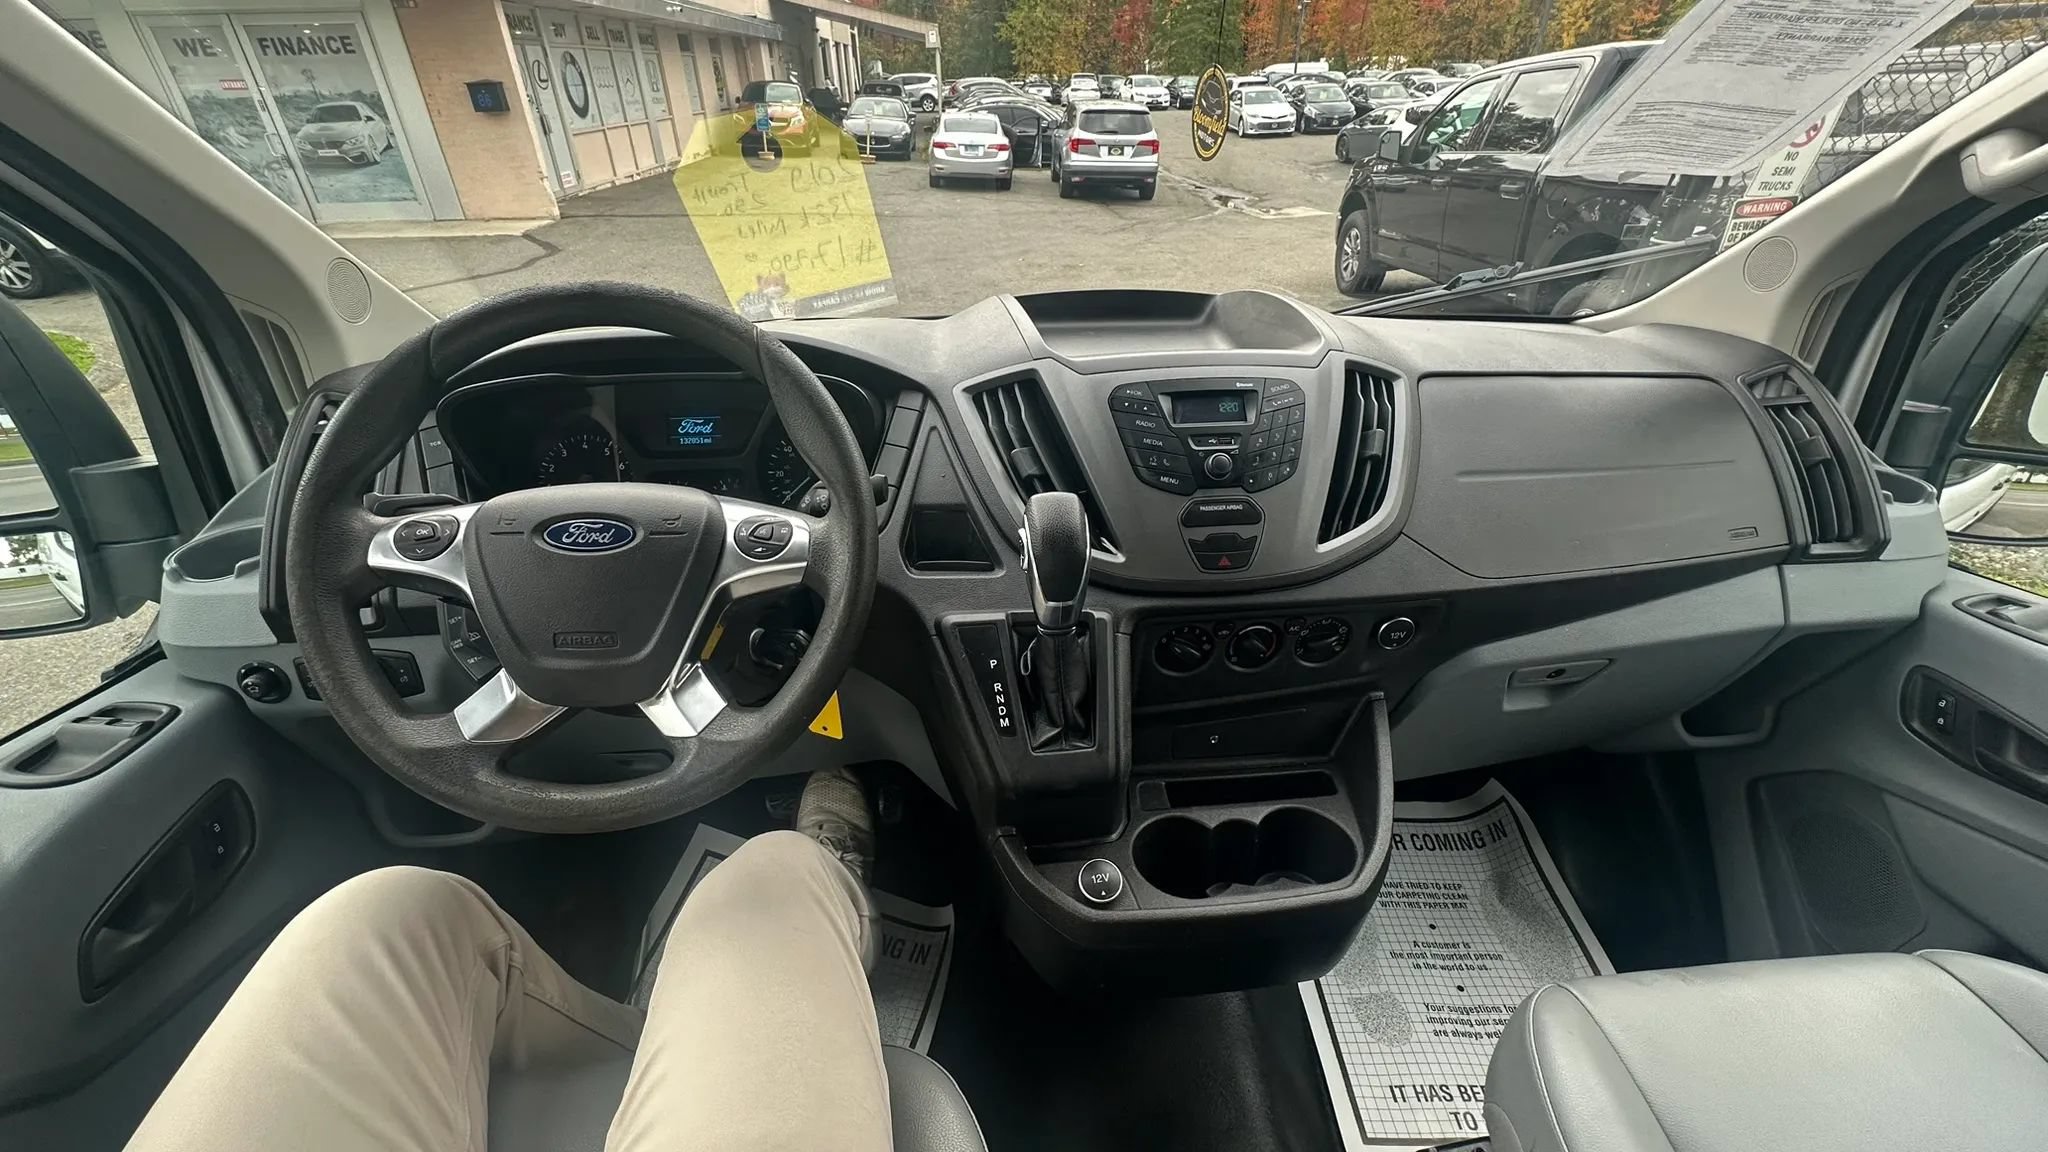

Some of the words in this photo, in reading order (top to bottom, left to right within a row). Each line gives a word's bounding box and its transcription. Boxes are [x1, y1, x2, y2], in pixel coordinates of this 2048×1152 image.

[552, 22, 567, 38] BUY
[584, 25, 601, 41] SELL
[172, 37, 219, 57] WE
[256, 35, 356, 57] FINANCE
[1784, 151, 1800, 161] NO
[1771, 167, 1796, 176] SEMI
[1757, 181, 1793, 191] TRUCKS
[1743, 201, 1787, 214] WARNING
[1731, 220, 1767, 231] BEWARE
[1727, 233, 1739, 243] OF
[678, 418, 714, 434] Ford
[1135, 419, 1156, 428] RADIO
[1143, 438, 1163, 446] MEDIA
[561, 449, 568, 457] 3
[604, 447, 610, 456] 5
[549, 464, 555, 473] 2
[619, 462, 625, 470] 6
[1160, 475, 1180, 485] MENU
[561, 522, 615, 545] Ford
[556, 633, 616, 647] AIRBAG
[1390, 631, 1407, 640] 12V
[989, 659, 998, 669] P
[993, 682, 1003, 692] R
[995, 693, 1005, 704] N
[998, 705, 1007, 716] D
[1000, 717, 1010, 727] M
[1409, 830, 1487, 851] COMING
[1487, 820, 1508, 843] IN
[1091, 872, 1110, 884] 12V
[1383, 881, 1404, 889] HAVE
[1405, 881, 1428, 890] TRIED
[1429, 882, 1441, 890] TO
[1443, 883, 1463, 891] KEEP
[1395, 891, 1441, 900] CARPETING
[1441, 892, 1469, 901] CLEAN
[1402, 901, 1421, 909] THIS
[1423, 901, 1451, 910] PAPER
[1412, 940, 1420, 948] A
[1421, 941, 1462, 949] customer
[1463, 941, 1471, 949] is
[909, 943, 932, 966] IN
[1389, 951, 1404, 959] the
[1406, 952, 1429, 960] most
[1430, 952, 1472, 961] important
[1473, 952, 1504, 961] person
[1412, 962, 1422, 970] in
[1423, 962, 1439, 970] the
[1440, 962, 1464, 971] world
[1465, 963, 1476, 971] to
[1423, 1002, 1445, 1012] Your
[1447, 1004, 1503, 1015] suggestions
[1425, 1015, 1474, 1028] improving
[1475, 1018, 1492, 1026] our
[1433, 1029, 1449, 1038] are
[1450, 1028, 1484, 1041] always
[1389, 1084, 1407, 1103] IT
[1412, 1084, 1454, 1102] HAS
[1449, 1110, 1478, 1131] TO
